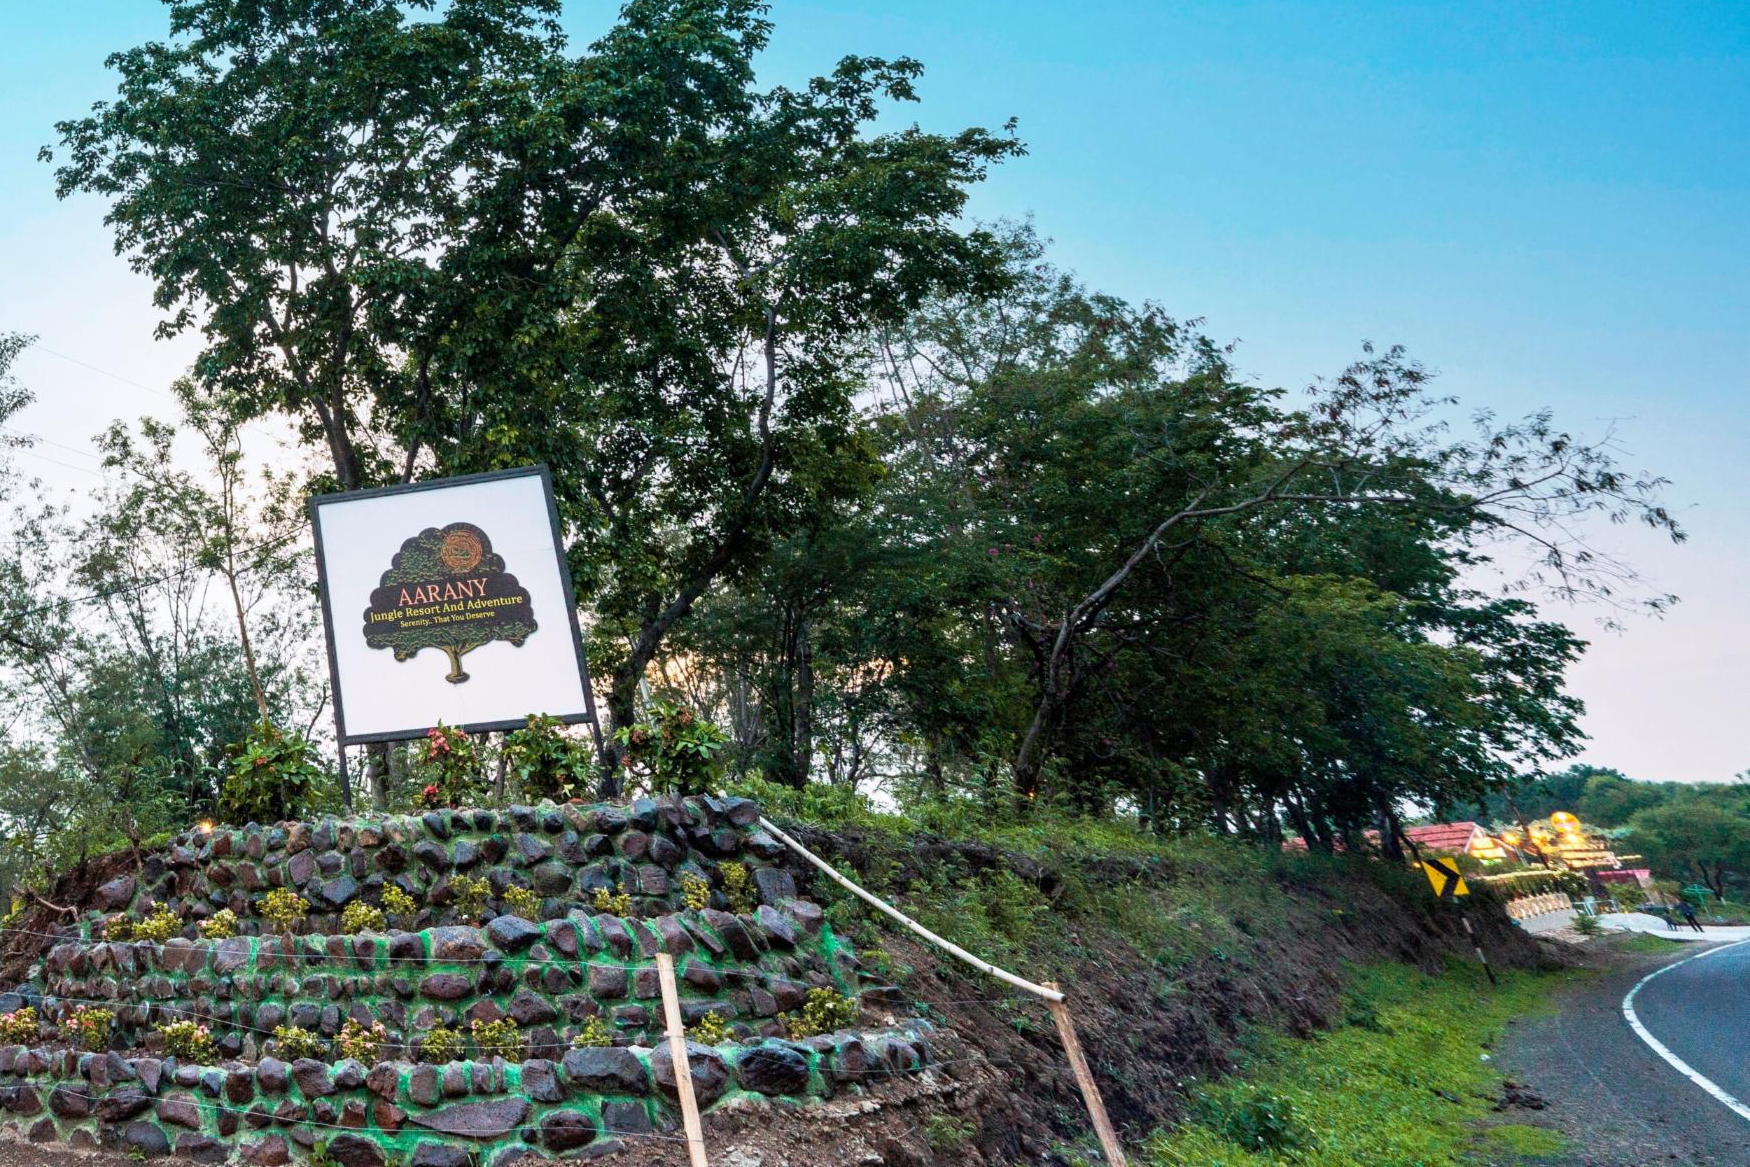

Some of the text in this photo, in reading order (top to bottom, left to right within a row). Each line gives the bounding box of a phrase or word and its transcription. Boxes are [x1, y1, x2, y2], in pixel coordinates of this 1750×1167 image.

[398, 578, 488, 606] AARANY
[370, 595, 523, 623] Jungle Resort And Adventure
[433, 616, 450, 624] That
[451, 614, 464, 622] You
[465, 611, 495, 620] Deserve
